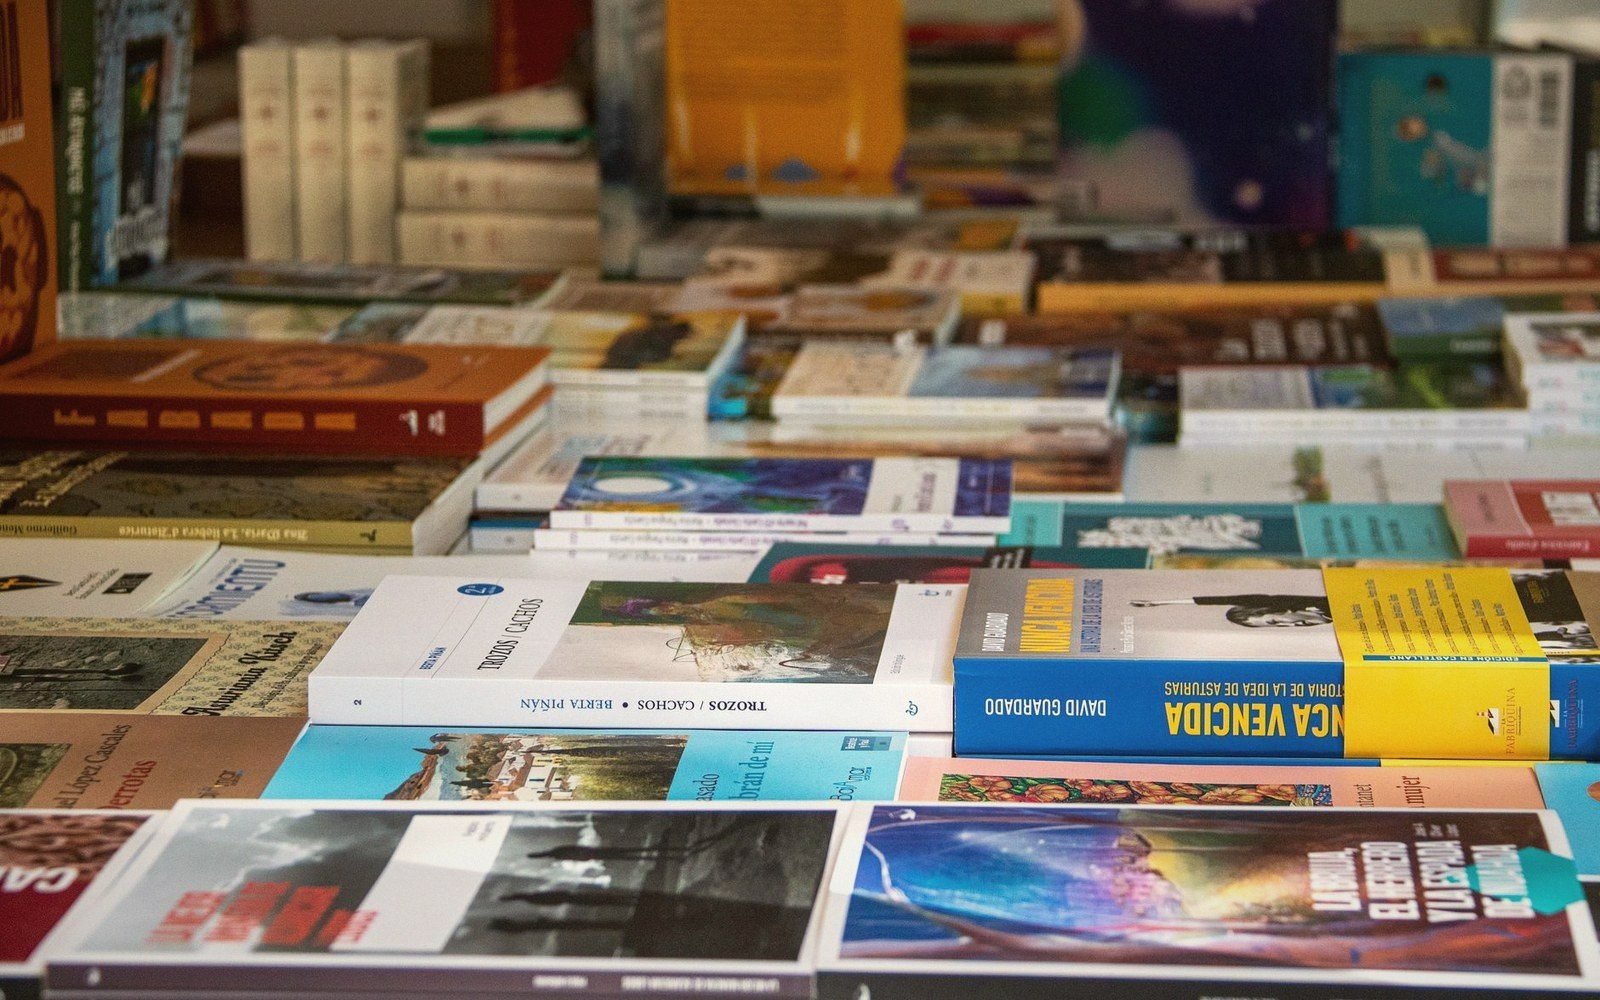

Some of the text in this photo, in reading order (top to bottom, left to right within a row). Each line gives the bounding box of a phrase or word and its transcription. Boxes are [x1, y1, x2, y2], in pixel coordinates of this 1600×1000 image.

[1019, 578, 1075, 652] NUNCA VENCIDA
[238, 631, 298, 662] Kitsch
[477, 640, 519, 670] TROZOS
[504, 598, 544, 633] CACHOS
[1164, 681, 1345, 697] TORIA DE LA IDEA DE ASTURIAS
[520, 698, 613, 713] BERTA PIÑÁN
[637, 699, 695, 711] CACHOS
[709, 700, 767, 711] TROZOS
[985, 697, 1107, 717] DAVID GUARDADO
[1164, 701, 1345, 738] NCA VENCIDA
[1505, 687, 1517, 755] FABRIQUINA
[60, 764, 102, 795] López
[85, 723, 132, 764] Cascales
[729, 741, 775, 801] brán de mí
[692, 773, 720, 801] asado
[1353, 784, 1375, 808] ntanet
[1396, 775, 1431, 804] mujer
[1415, 840, 1471, 888] ESPADA
[0, 866, 79, 894] CA
[1360, 841, 1421, 920] EL HERRERO
[1311, 890, 1362, 911] LA
[1423, 889, 1476, 909] LA
[1482, 896, 1536, 919] DE
[1427, 908, 1478, 923] Y
